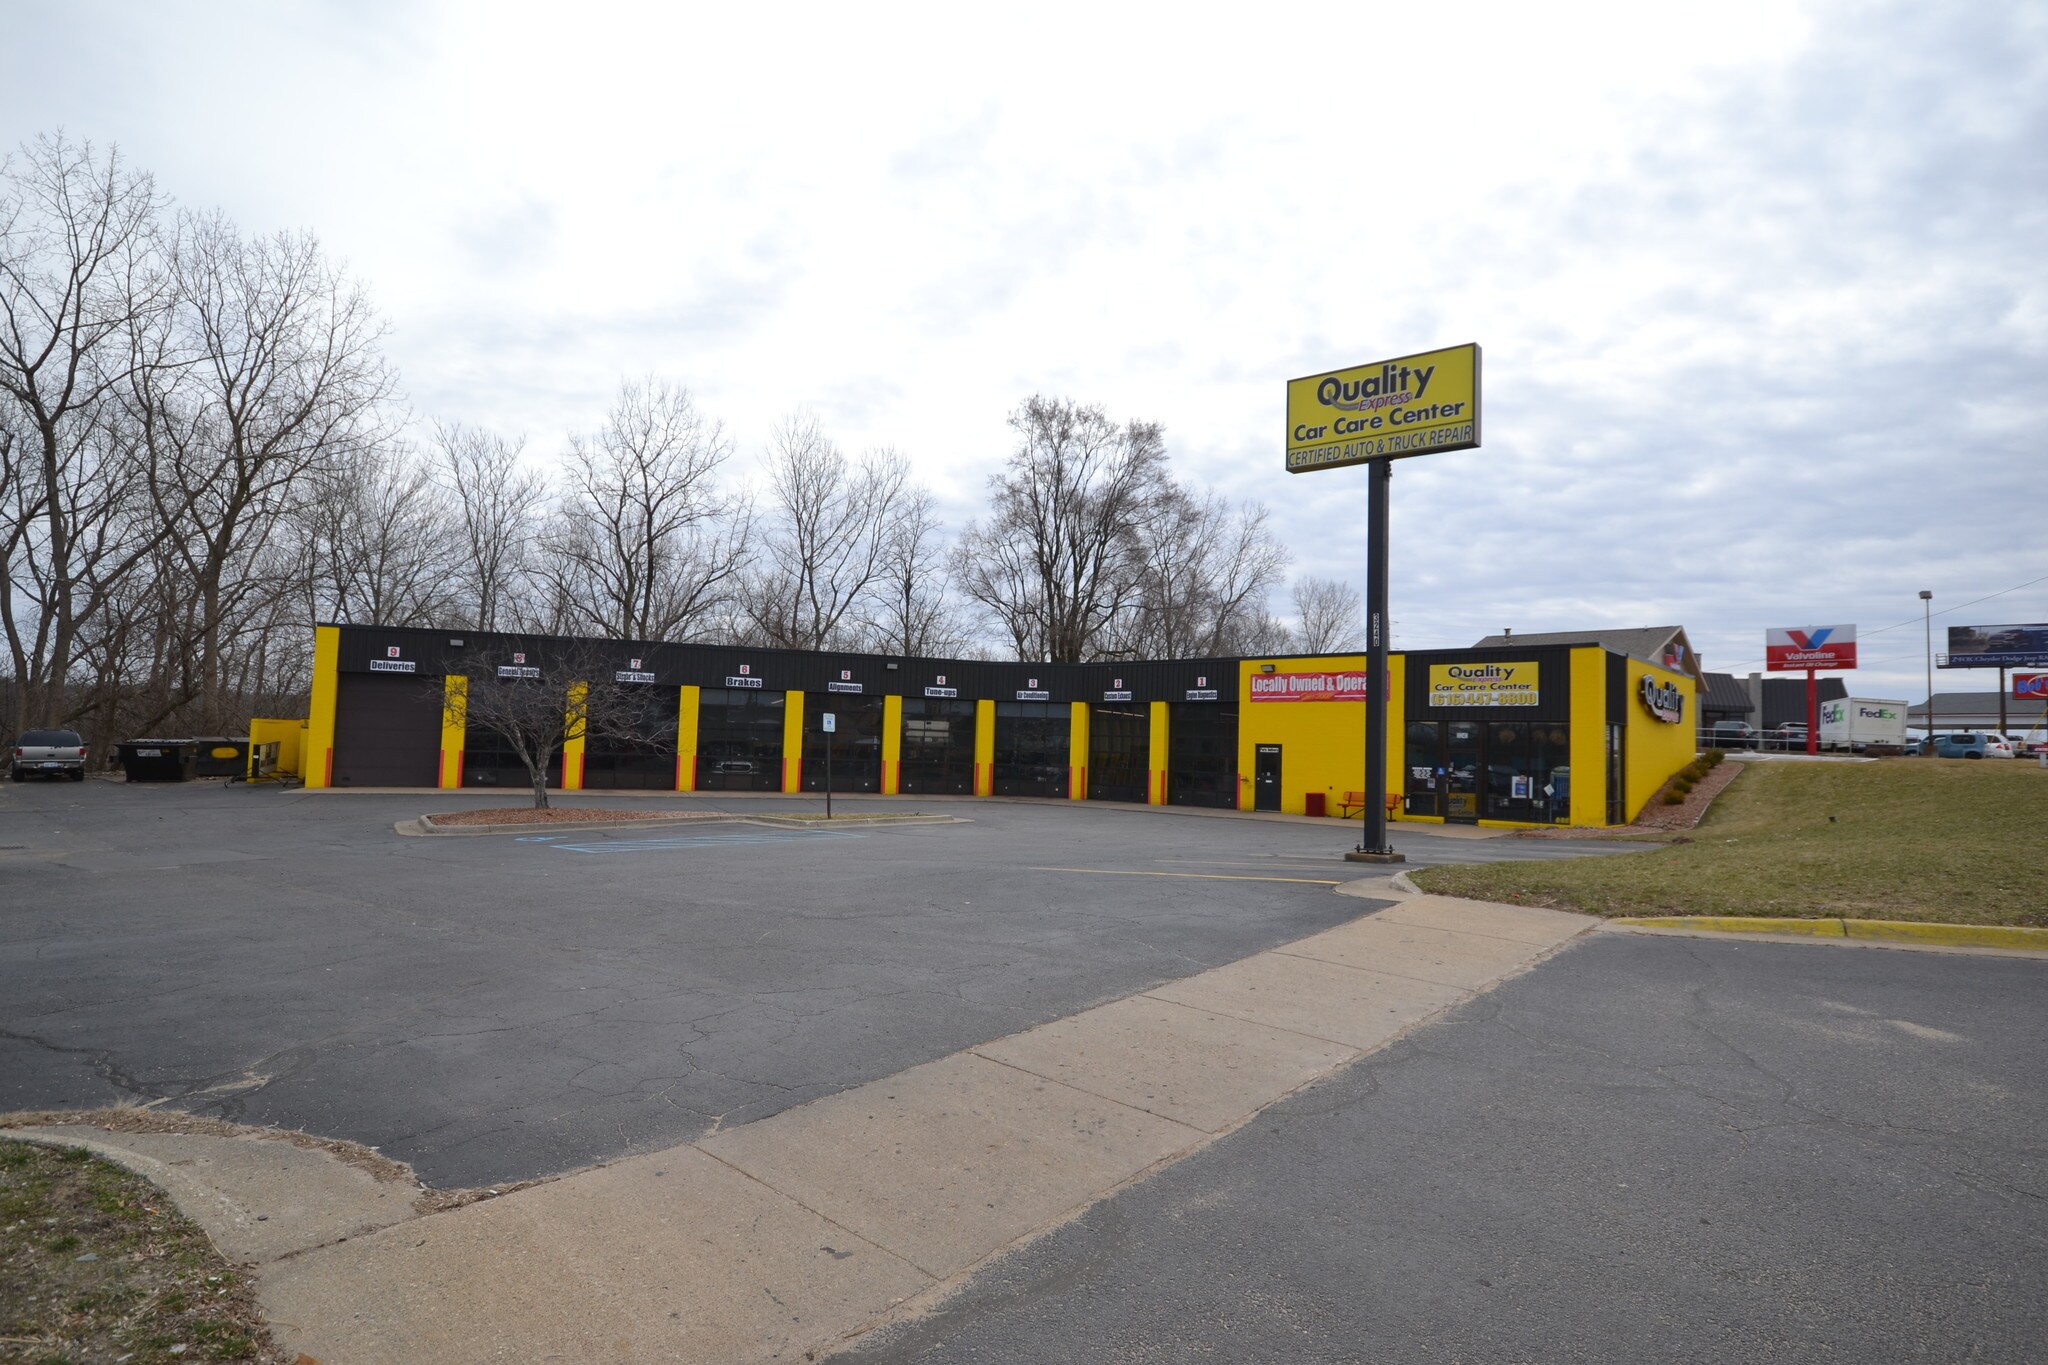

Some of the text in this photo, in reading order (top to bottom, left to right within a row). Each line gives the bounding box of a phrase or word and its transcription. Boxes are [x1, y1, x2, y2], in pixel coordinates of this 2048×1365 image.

[1317, 364, 1435, 408] Quality
[1358, 392, 1413, 412] Express
[1294, 402, 1465, 441] Car Care Center
[1288, 424, 1472, 467] CERTIFIED AUTO & TRUCK REPAIR
[390, 647, 397, 657] 9
[1785, 651, 1836, 660] Valvoline
[371, 660, 415, 671] Deliveries
[633, 660, 639, 668] 7
[742, 665, 748, 674] 6
[843, 671, 849, 679] 5
[1448, 665, 1515, 681] Quality
[726, 677, 761, 688] Brakes
[938, 676, 944, 684] 4
[1030, 679, 1036, 687] 3
[1116, 679, 1121, 688] 2
[1252, 674, 1367, 693] Locally Owned & Opera
[926, 688, 957, 697] Tune-ups
[1434, 683, 1532, 691] Car Care Center
[1641, 674, 1685, 724] Quality
[1822, 703, 1845, 725] FedEx
[1860, 707, 1897, 719] FedEx
